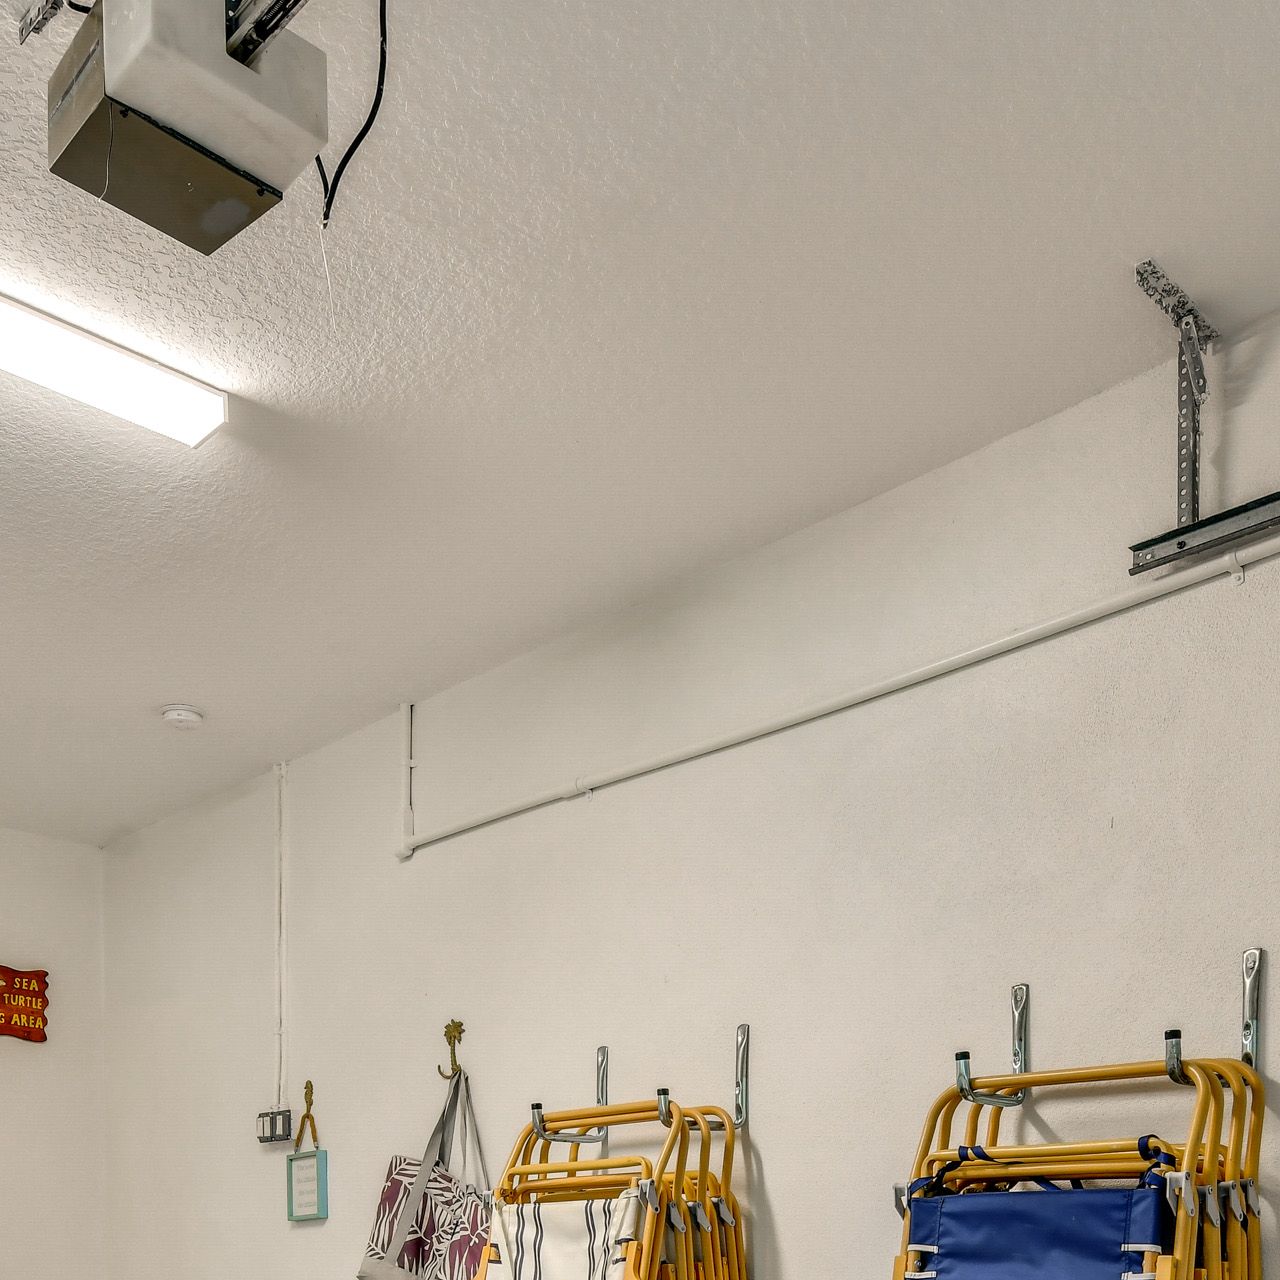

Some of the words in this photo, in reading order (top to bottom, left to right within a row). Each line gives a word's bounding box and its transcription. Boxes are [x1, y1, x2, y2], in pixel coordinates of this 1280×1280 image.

[13, 977, 39, 992] SEA
[3, 993, 43, 1010] TURTLE
[11, 1013, 44, 1029] AREA
